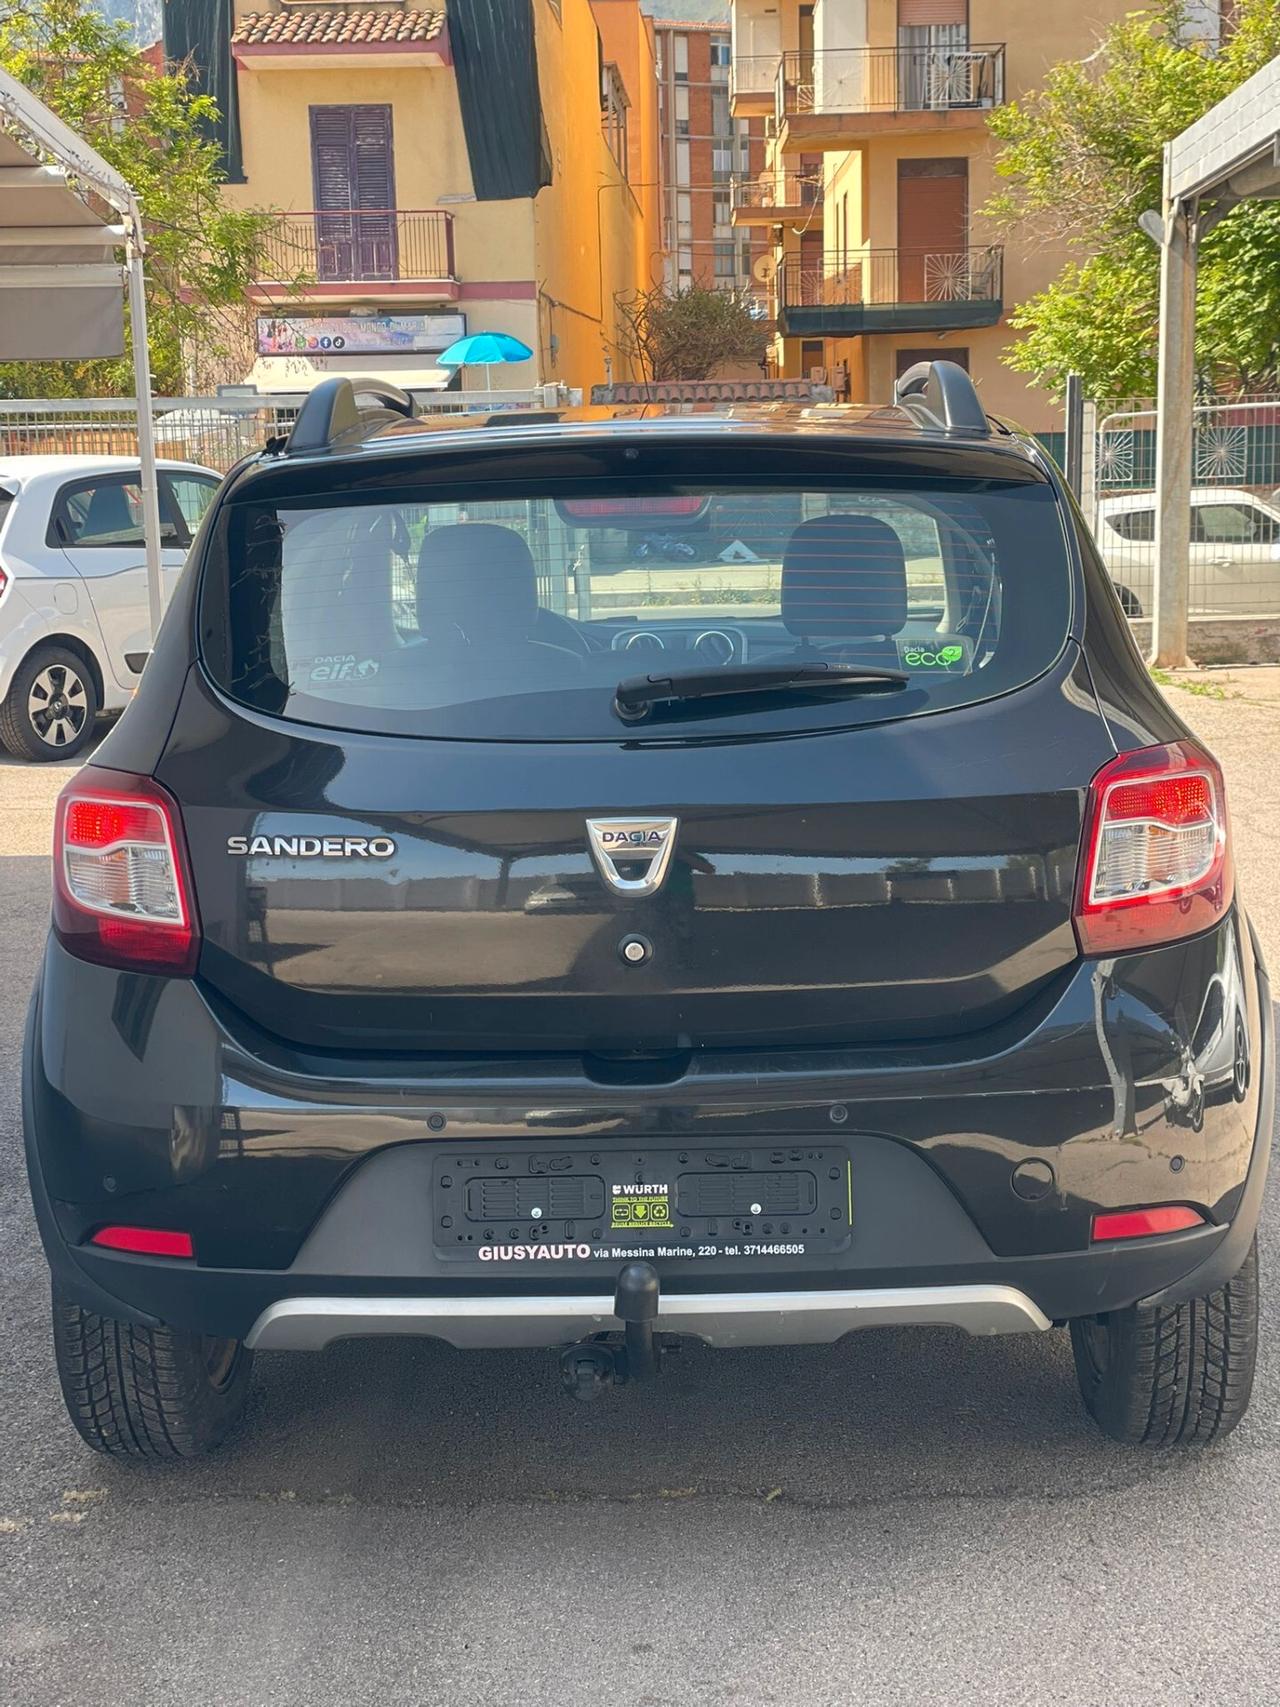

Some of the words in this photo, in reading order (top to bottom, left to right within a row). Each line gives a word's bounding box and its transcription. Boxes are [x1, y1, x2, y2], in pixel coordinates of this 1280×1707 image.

[314, 654, 356, 664] DACIA
[602, 831, 661, 843] DACIA
[227, 836, 395, 857] SANDERO
[478, 1244, 591, 1261] GIUSYAUTO
[594, 1248, 609, 1258] via
[612, 1247, 654, 1258] Messina
[657, 1246, 696, 1257] Marine,
[698, 1246, 717, 1256] 220
[725, 1245, 741, 1255] tel.
[743, 1244, 805, 1255] 3714466505
